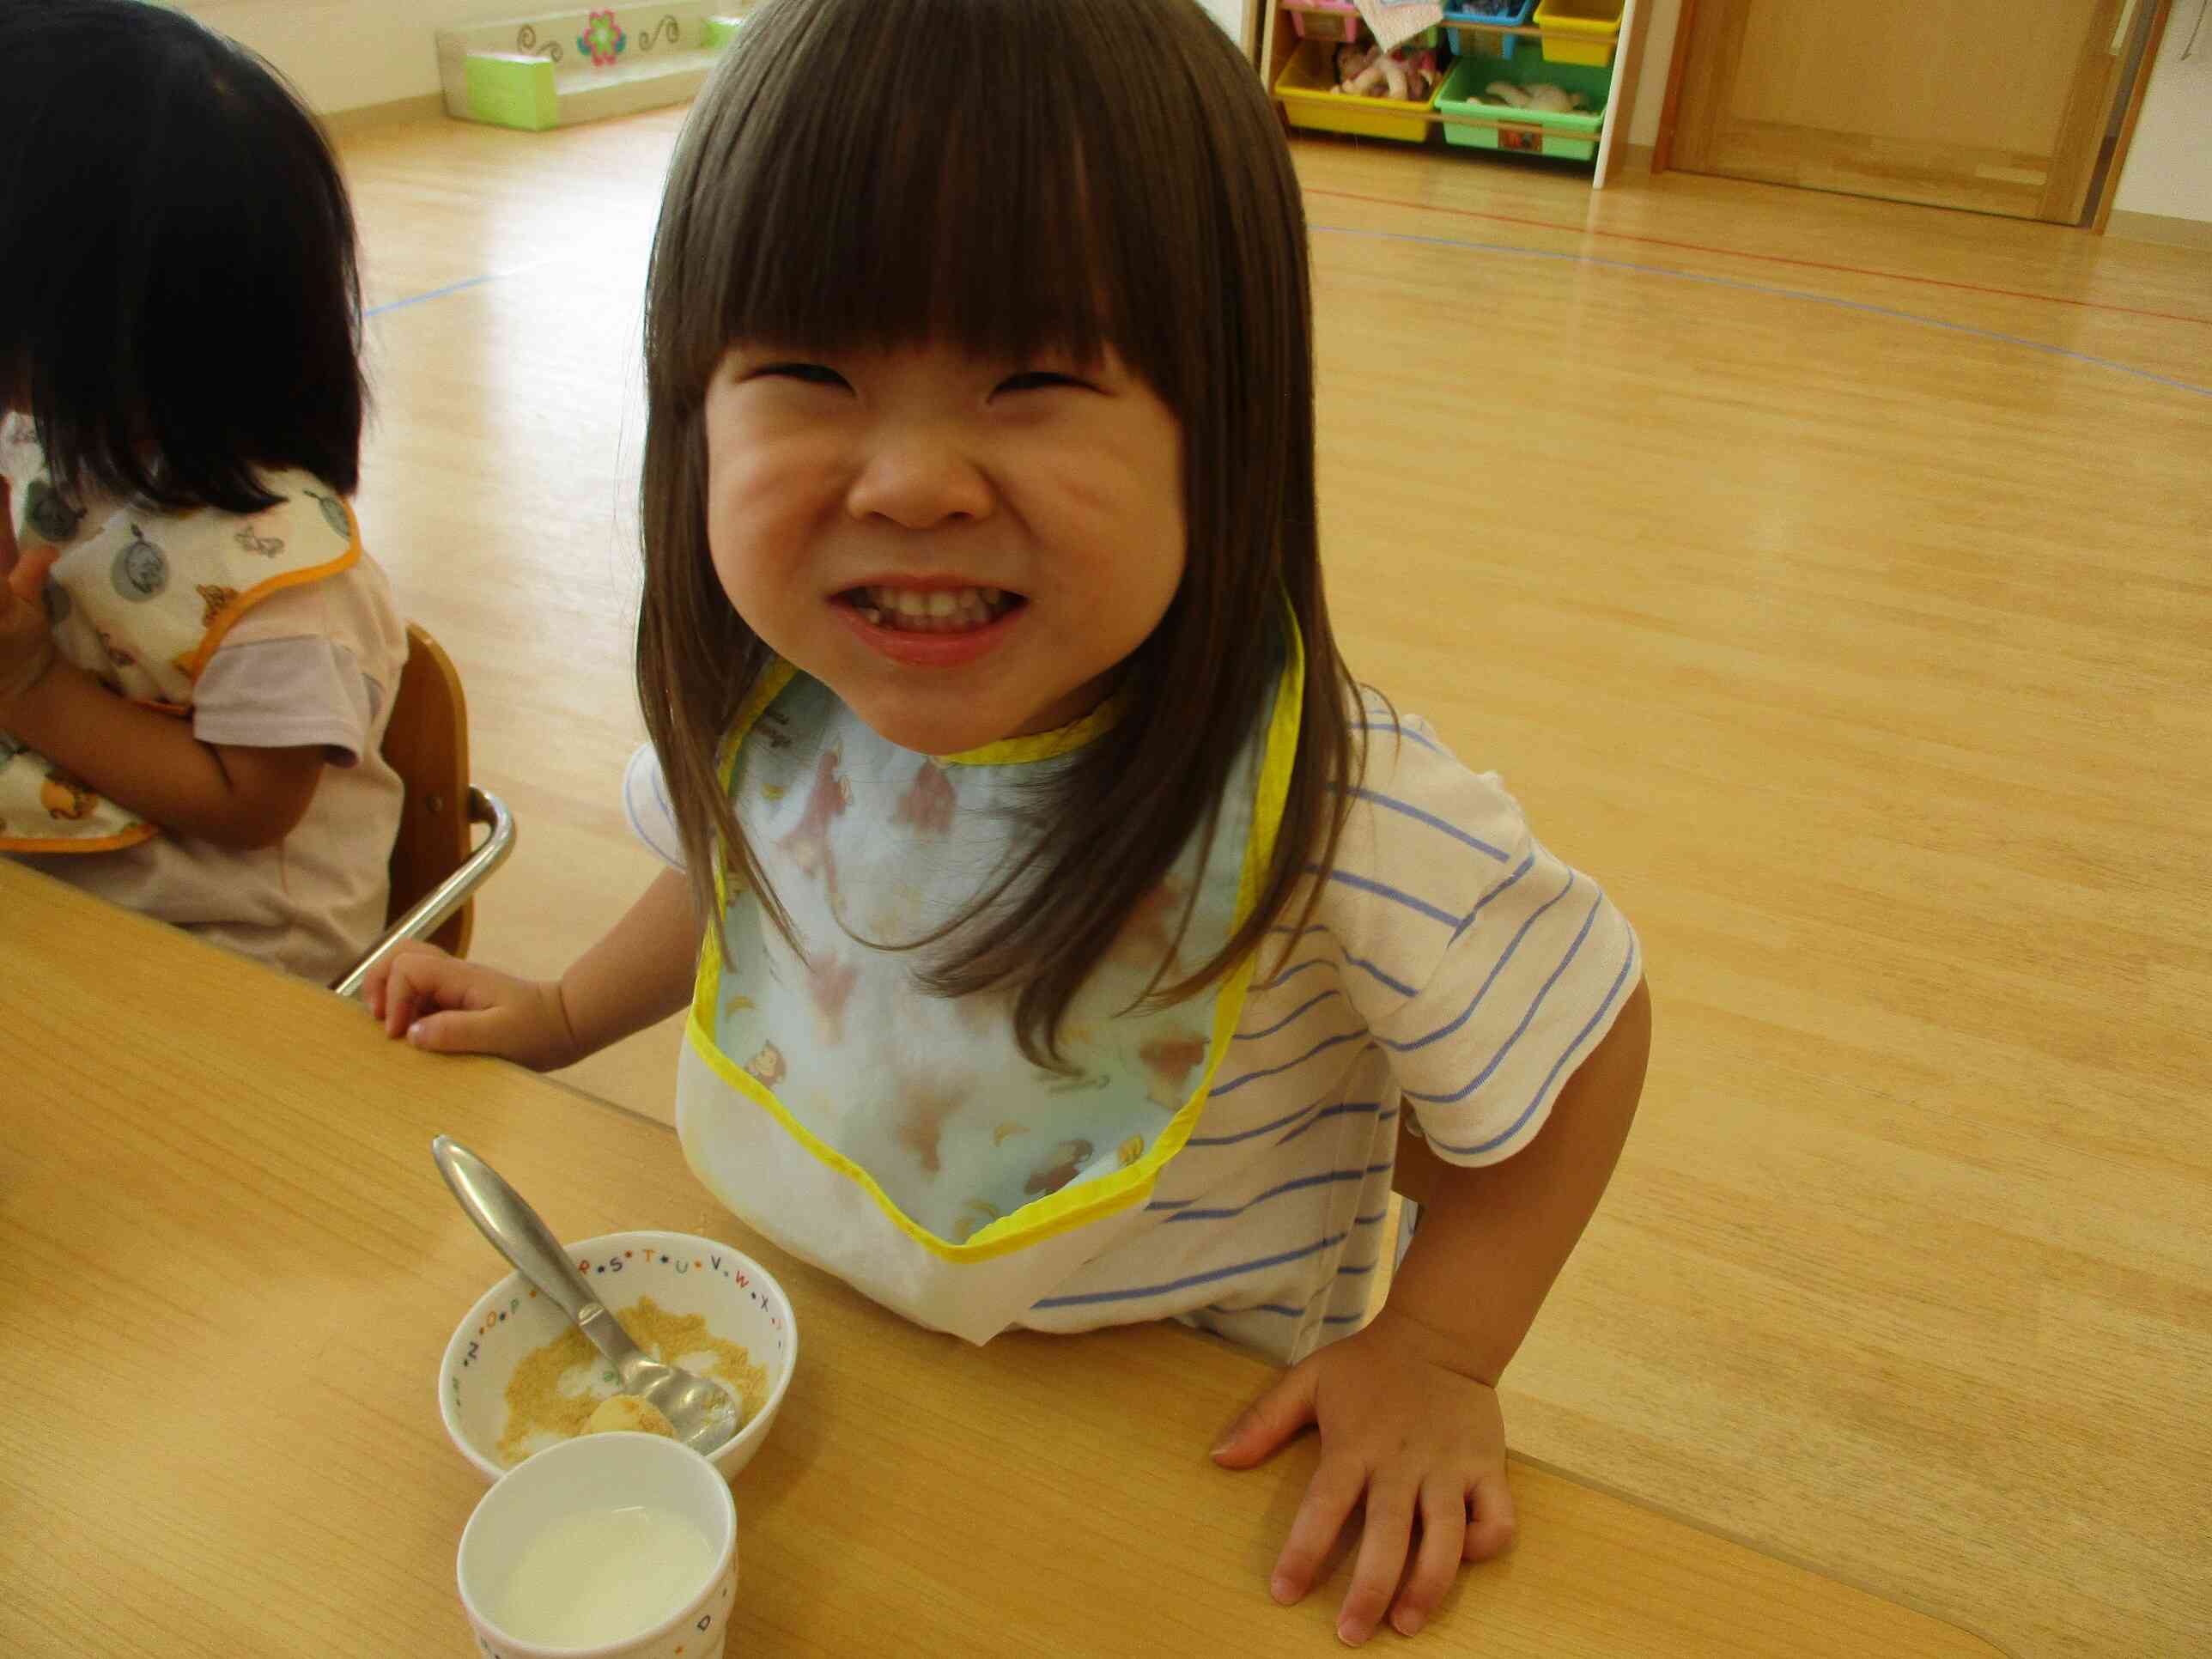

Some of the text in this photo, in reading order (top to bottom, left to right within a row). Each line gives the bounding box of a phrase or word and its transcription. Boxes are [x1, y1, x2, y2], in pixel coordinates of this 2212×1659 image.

[609, 1256, 623, 1273] S
[641, 1249, 657, 1265] T
[674, 1259, 690, 1274] U
[710, 1255, 721, 1270] V
[734, 1270, 750, 1288] W
[760, 1292, 769, 1313] X
